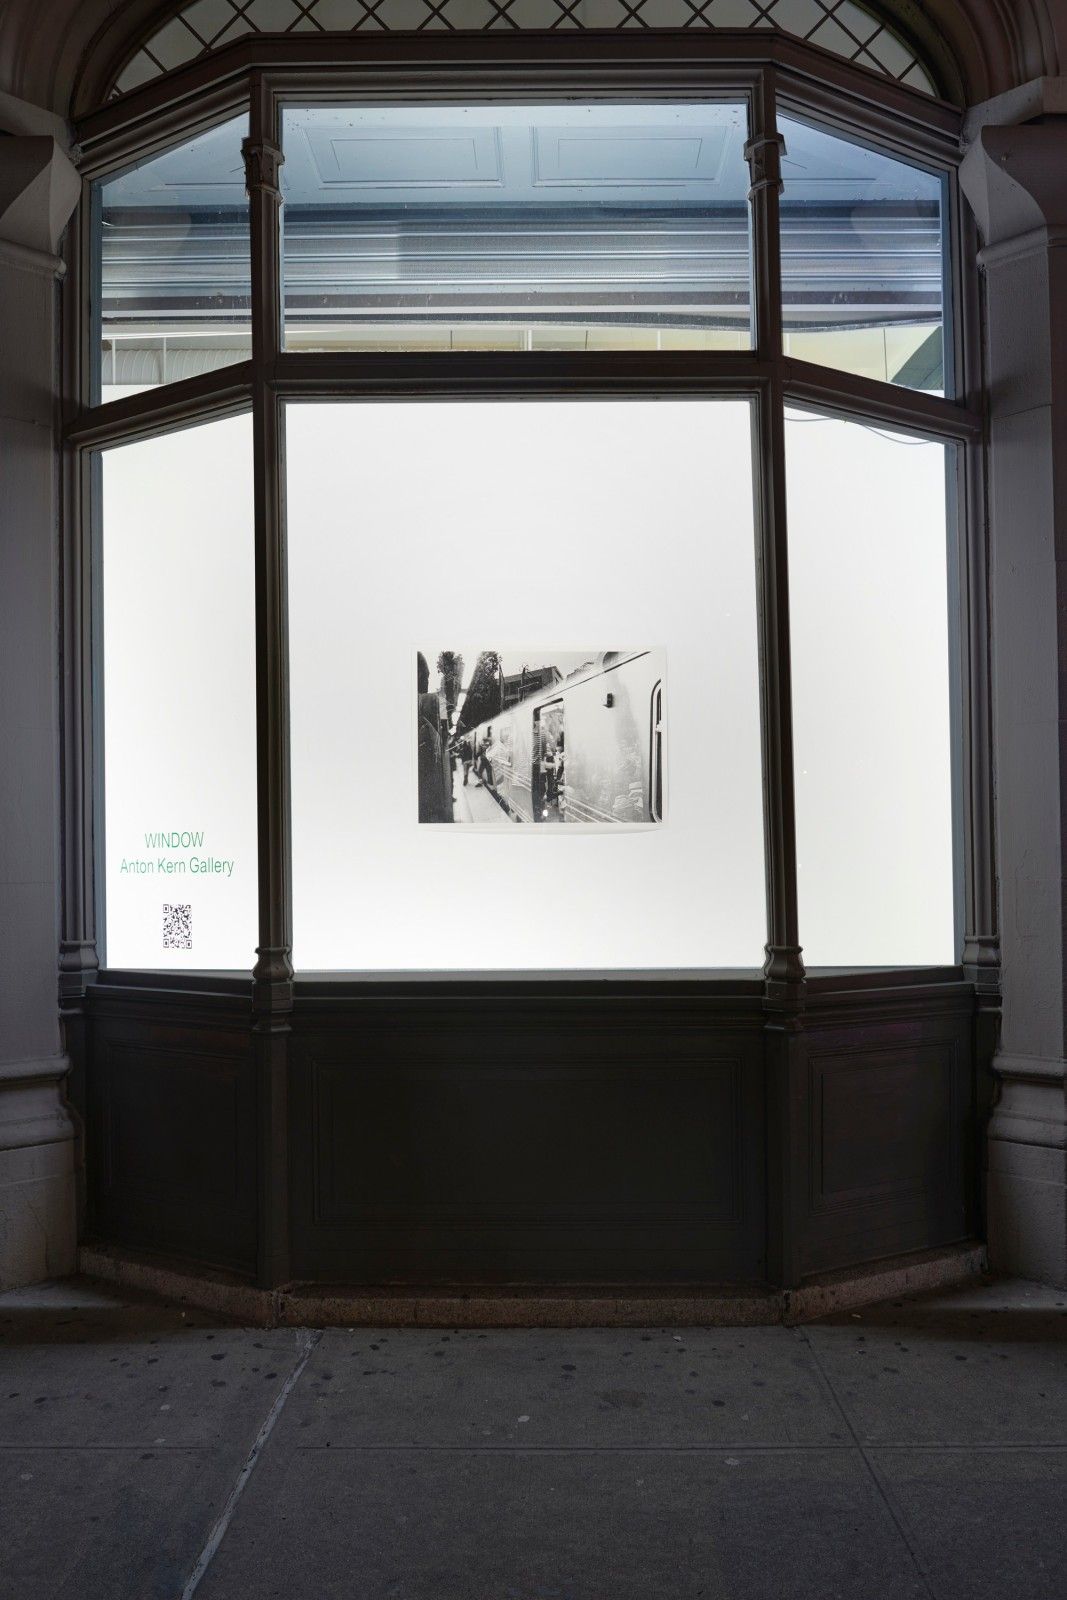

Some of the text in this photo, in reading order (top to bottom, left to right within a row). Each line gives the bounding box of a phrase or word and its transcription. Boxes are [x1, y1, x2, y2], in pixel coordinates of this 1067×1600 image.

[145, 831, 204, 848] WINDOW
[120, 856, 234, 877] Anton Kern Gallery
